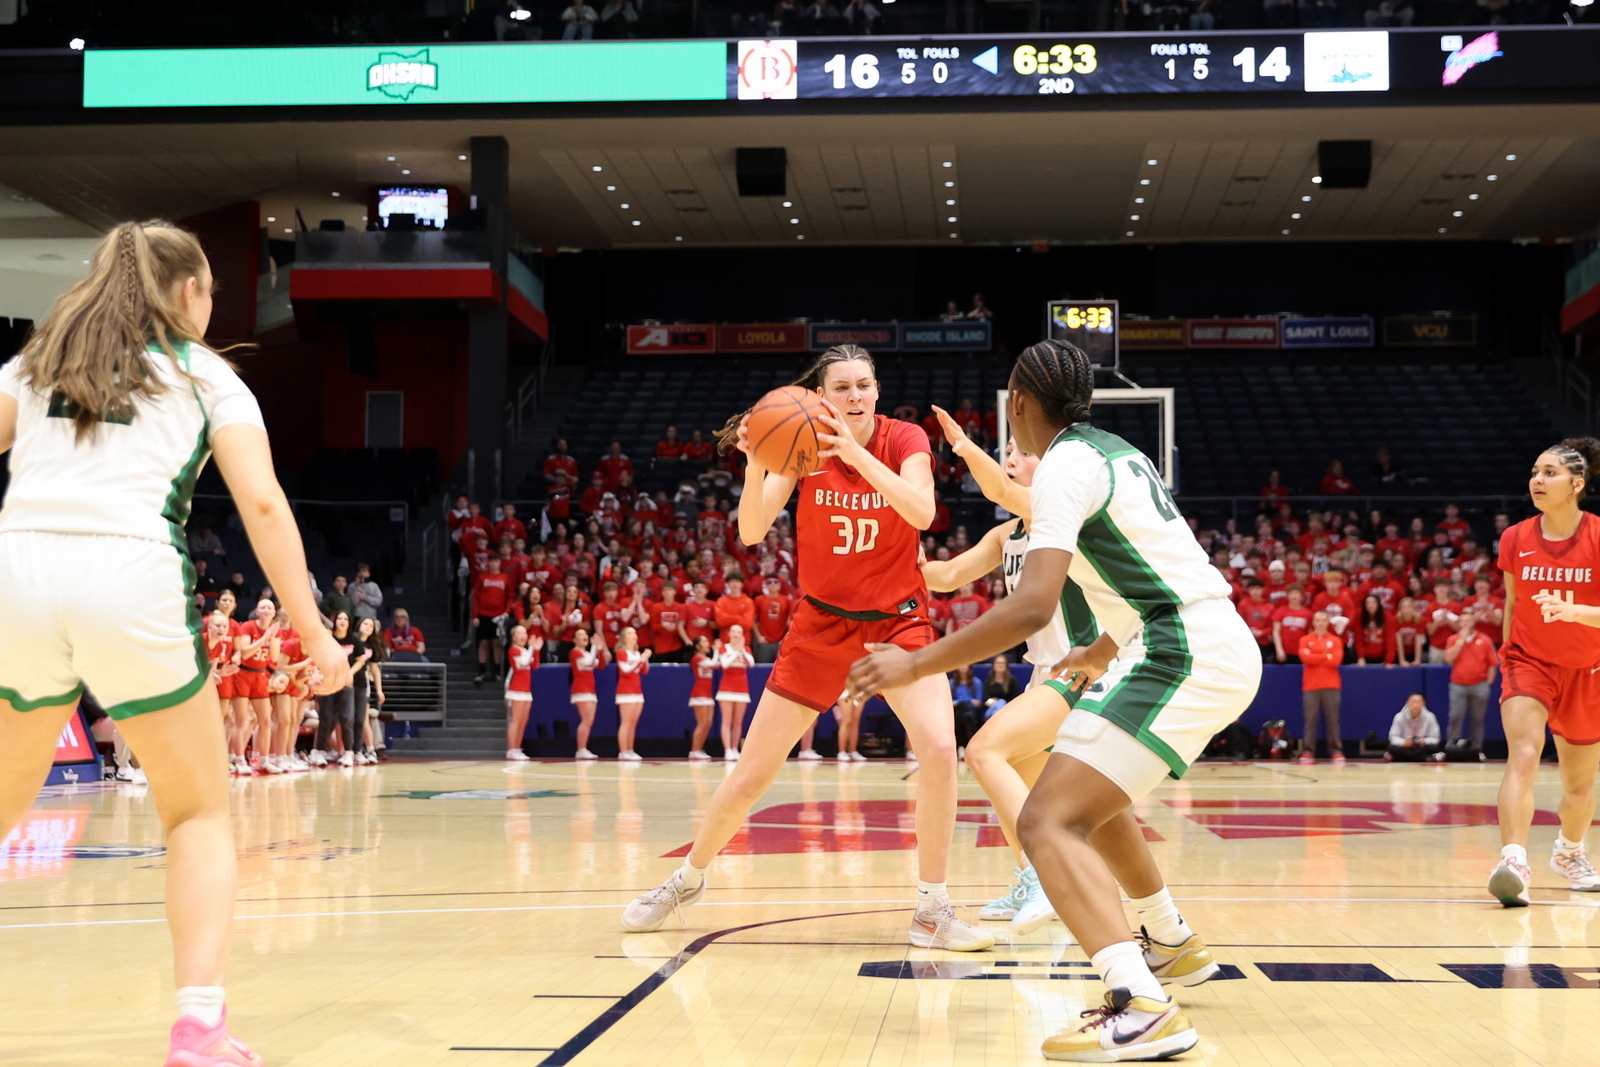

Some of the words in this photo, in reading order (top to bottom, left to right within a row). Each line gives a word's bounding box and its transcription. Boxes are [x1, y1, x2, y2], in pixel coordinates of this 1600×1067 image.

[897, 47, 919, 60] TOL
[922, 46, 960, 59] FOULS
[1012, 44, 1098, 75] 6:33
[1150, 42, 1188, 56] FOULS
[1189, 42, 1212, 56] TOL
[369, 62, 435, 87] OHSAA
[760, 56, 780, 80] B
[823, 53, 881, 89] 16
[900, 62, 917, 84] 5
[932, 62, 949, 84] 0
[1164, 58, 1175, 80] 1
[1192, 58, 1210, 80] 5
[1232, 47, 1291, 83] 14
[1038, 78, 1075, 95] 2ND
[1066, 306, 1112, 329] 6:33
[737, 331, 786, 344] LOYOLA
[905, 330, 942, 343] RHODE
[945, 330, 986, 342] ISLAND
[1285, 325, 1325, 339] SAINT
[1329, 324, 1370, 338] LOUIS
[1412, 324, 1450, 338] VCU
[830, 514, 880, 555] 30
[1521, 565, 1593, 583] BELLEVUE
